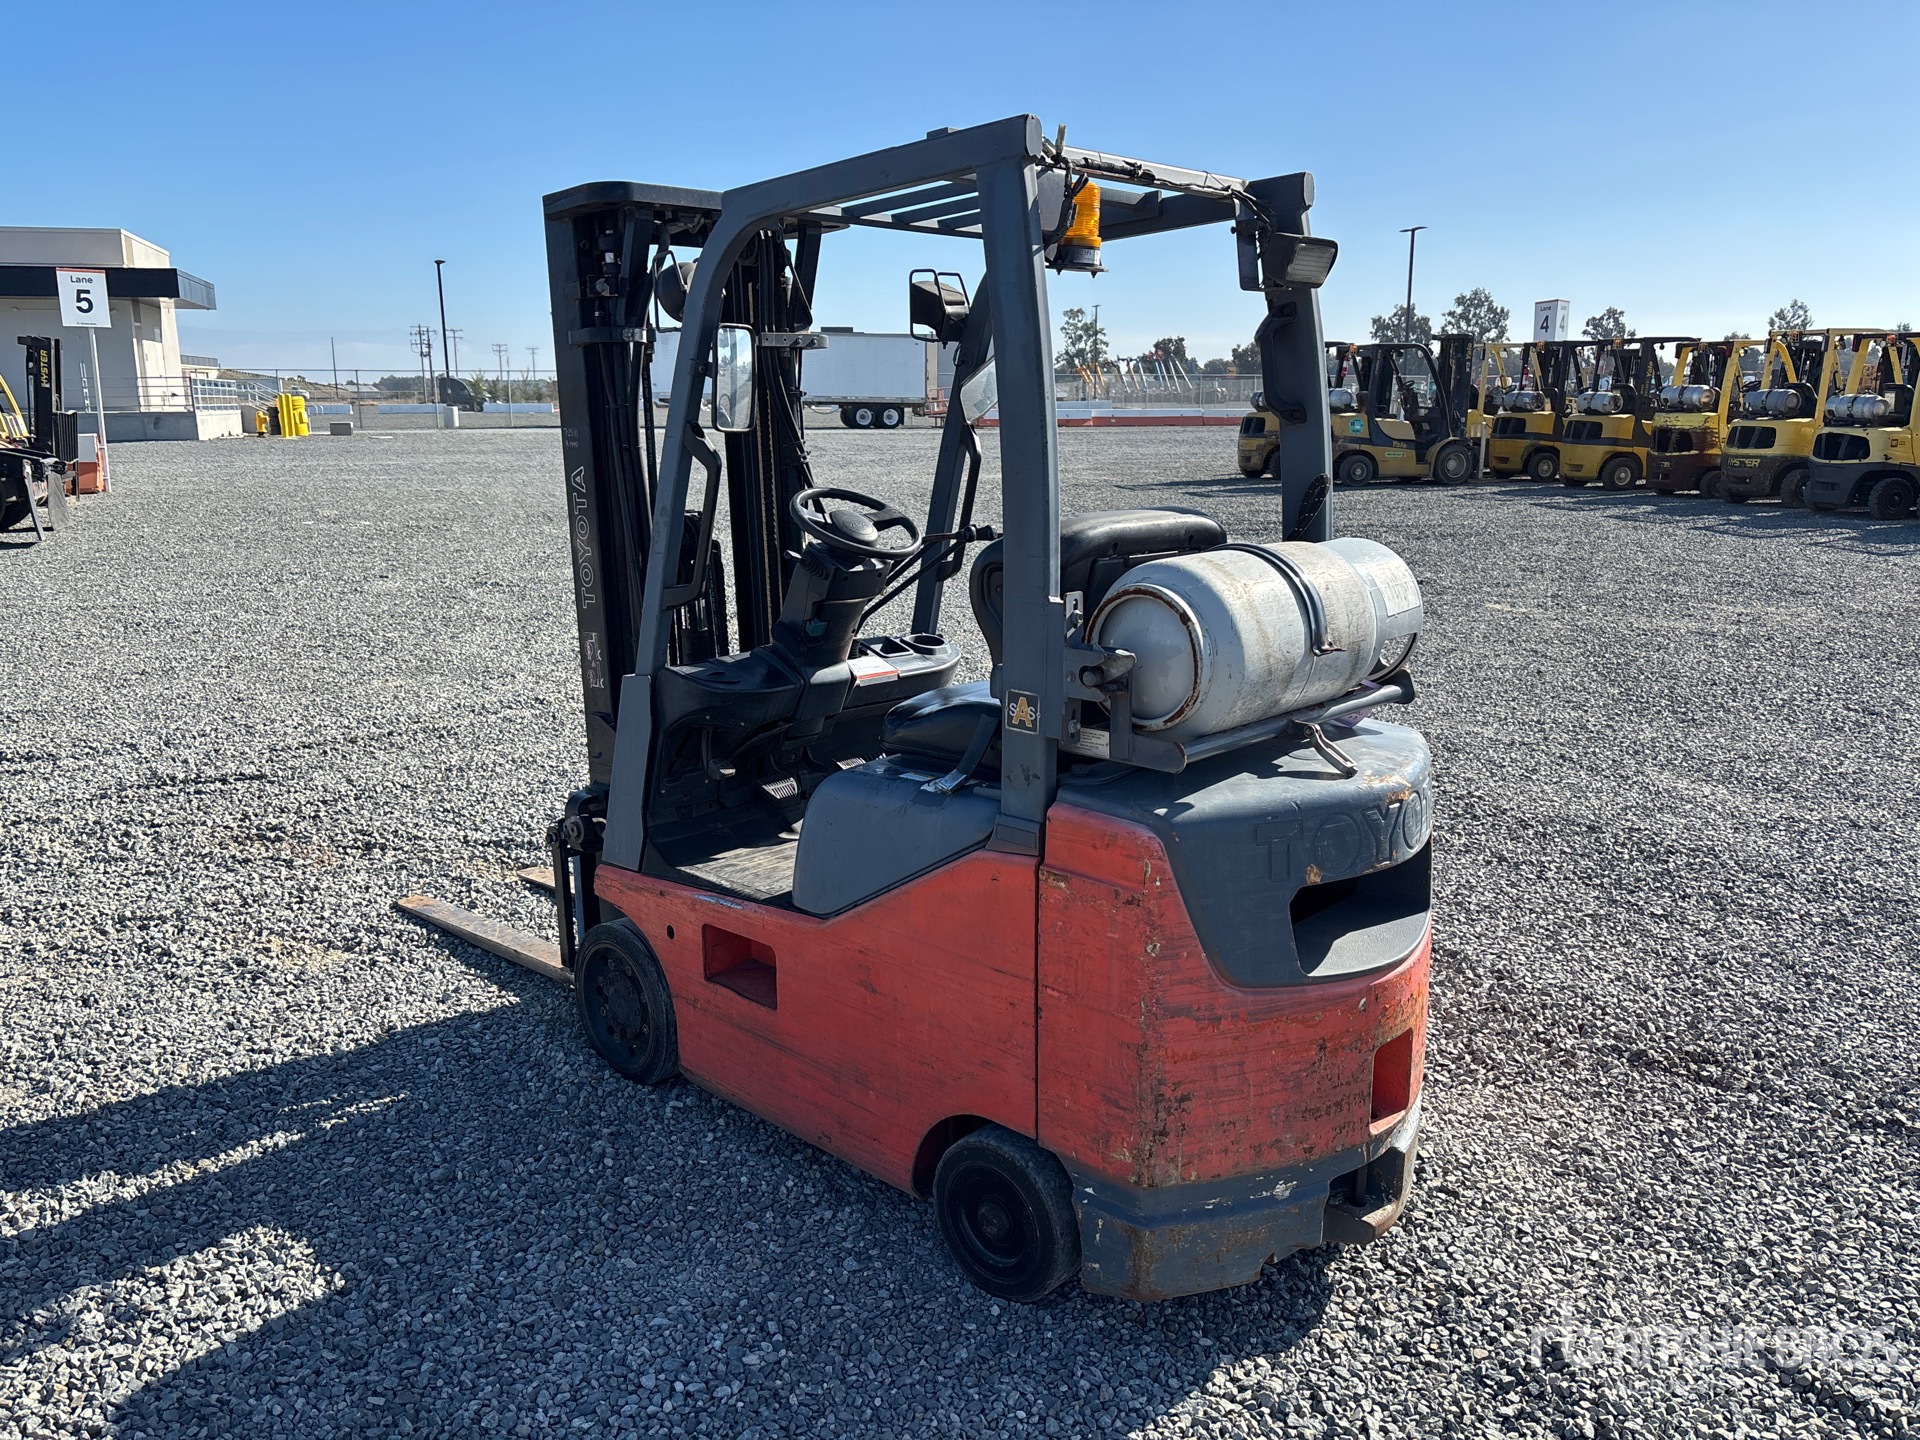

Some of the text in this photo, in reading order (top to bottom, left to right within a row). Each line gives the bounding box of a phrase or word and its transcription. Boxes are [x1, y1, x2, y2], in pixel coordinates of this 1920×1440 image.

[70, 275, 93, 284] Lane
[76, 289, 94, 314] 5
[1540, 315, 1549, 333] 4
[1559, 315, 1565, 332] 4
[40, 350, 50, 388] HYSTER
[571, 466, 596, 608] TOYOTA
